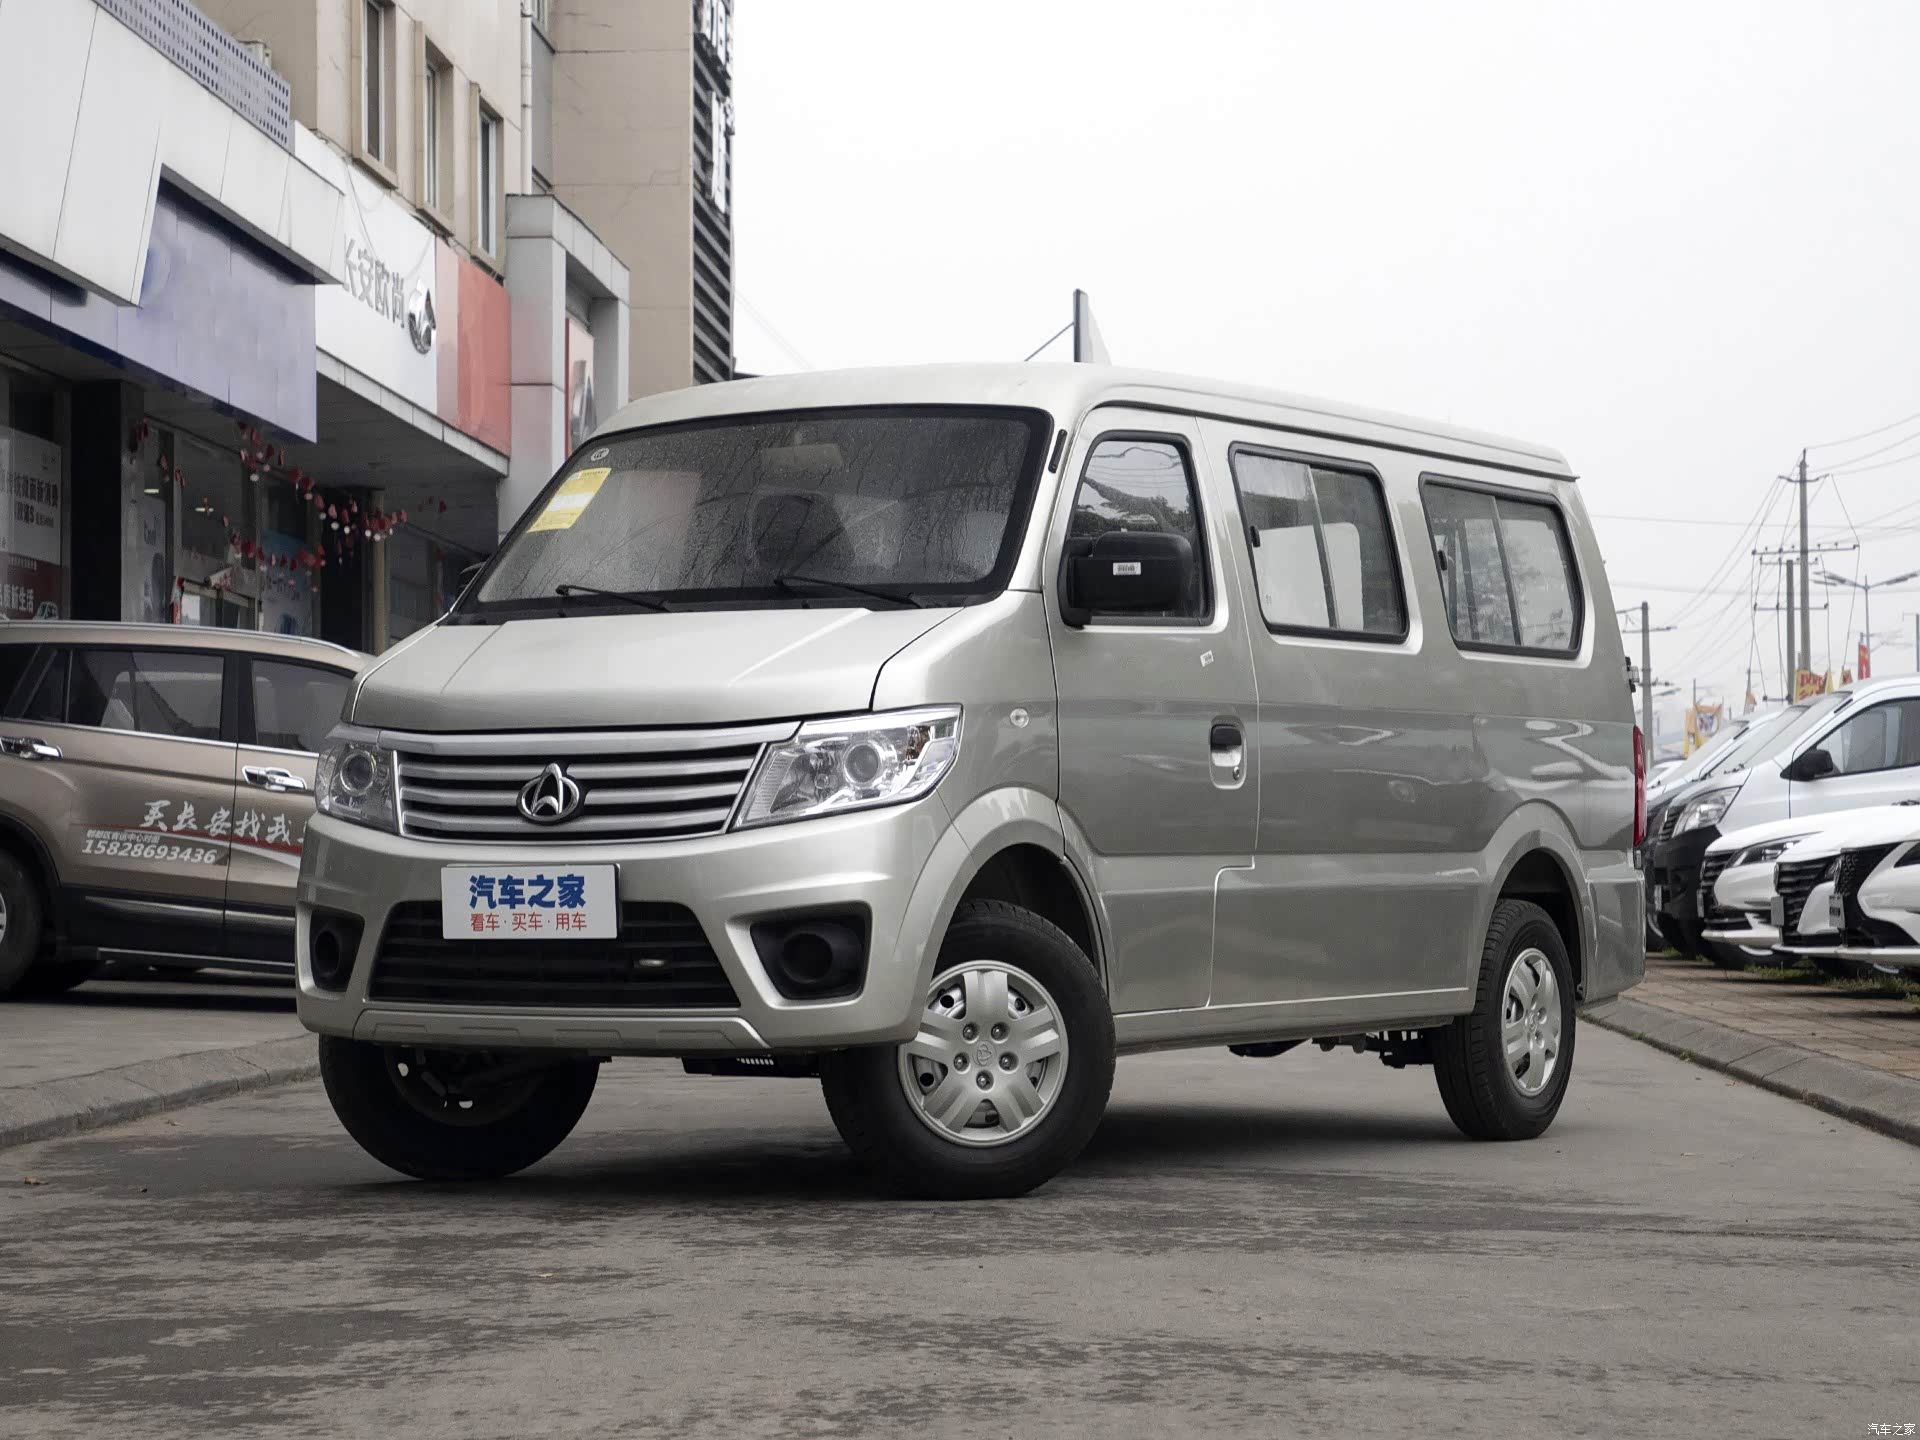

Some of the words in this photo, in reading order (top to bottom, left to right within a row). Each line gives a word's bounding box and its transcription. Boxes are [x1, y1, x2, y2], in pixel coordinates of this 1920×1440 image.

[139, 800, 305, 846] 买长安找我
[82, 839, 217, 865] 15828693436
[469, 873, 586, 910] 汽车之家
